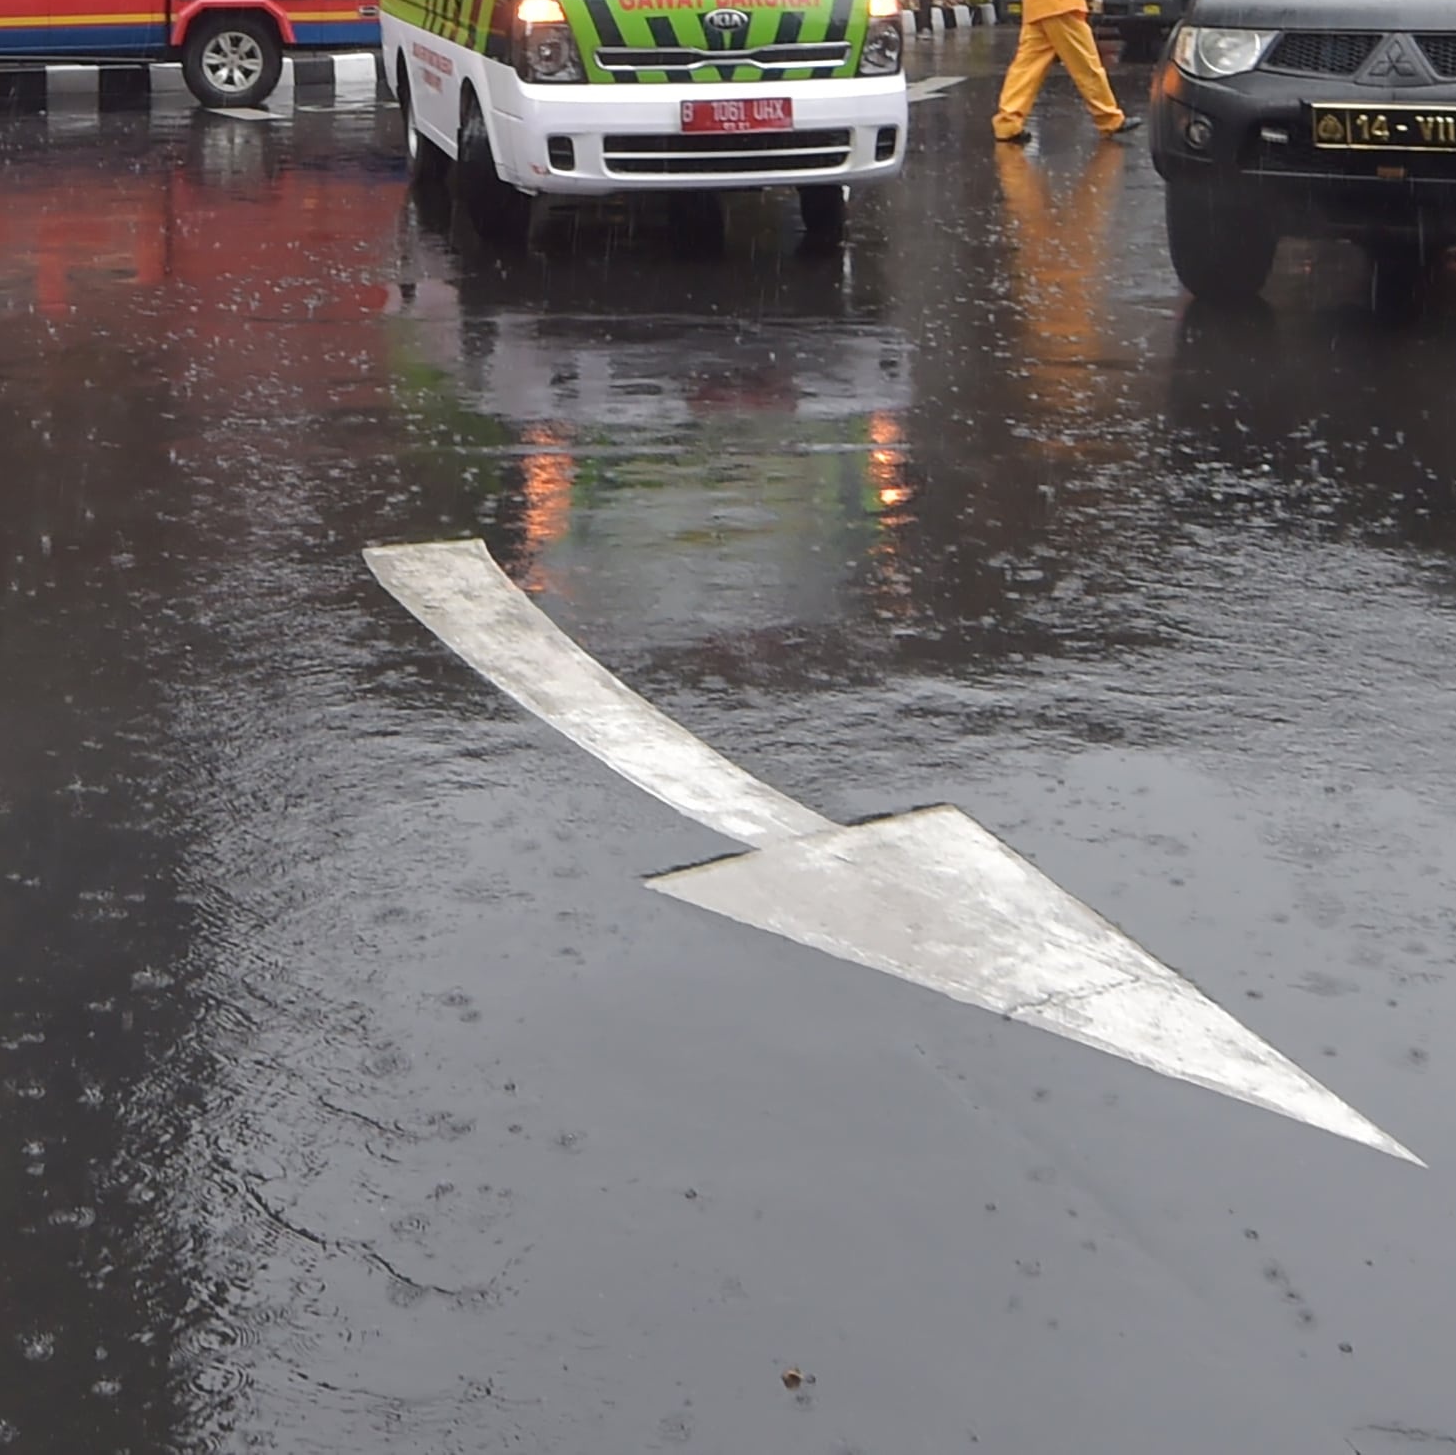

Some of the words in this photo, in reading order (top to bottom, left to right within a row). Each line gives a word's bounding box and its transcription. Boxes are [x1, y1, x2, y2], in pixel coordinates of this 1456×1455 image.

[711, 13, 743, 28] KIA
[682, 102, 694, 123] B
[711, 101, 745, 122] 1061
[753, 99, 785, 121] UHX
[1355, 114, 1390, 141] 14
